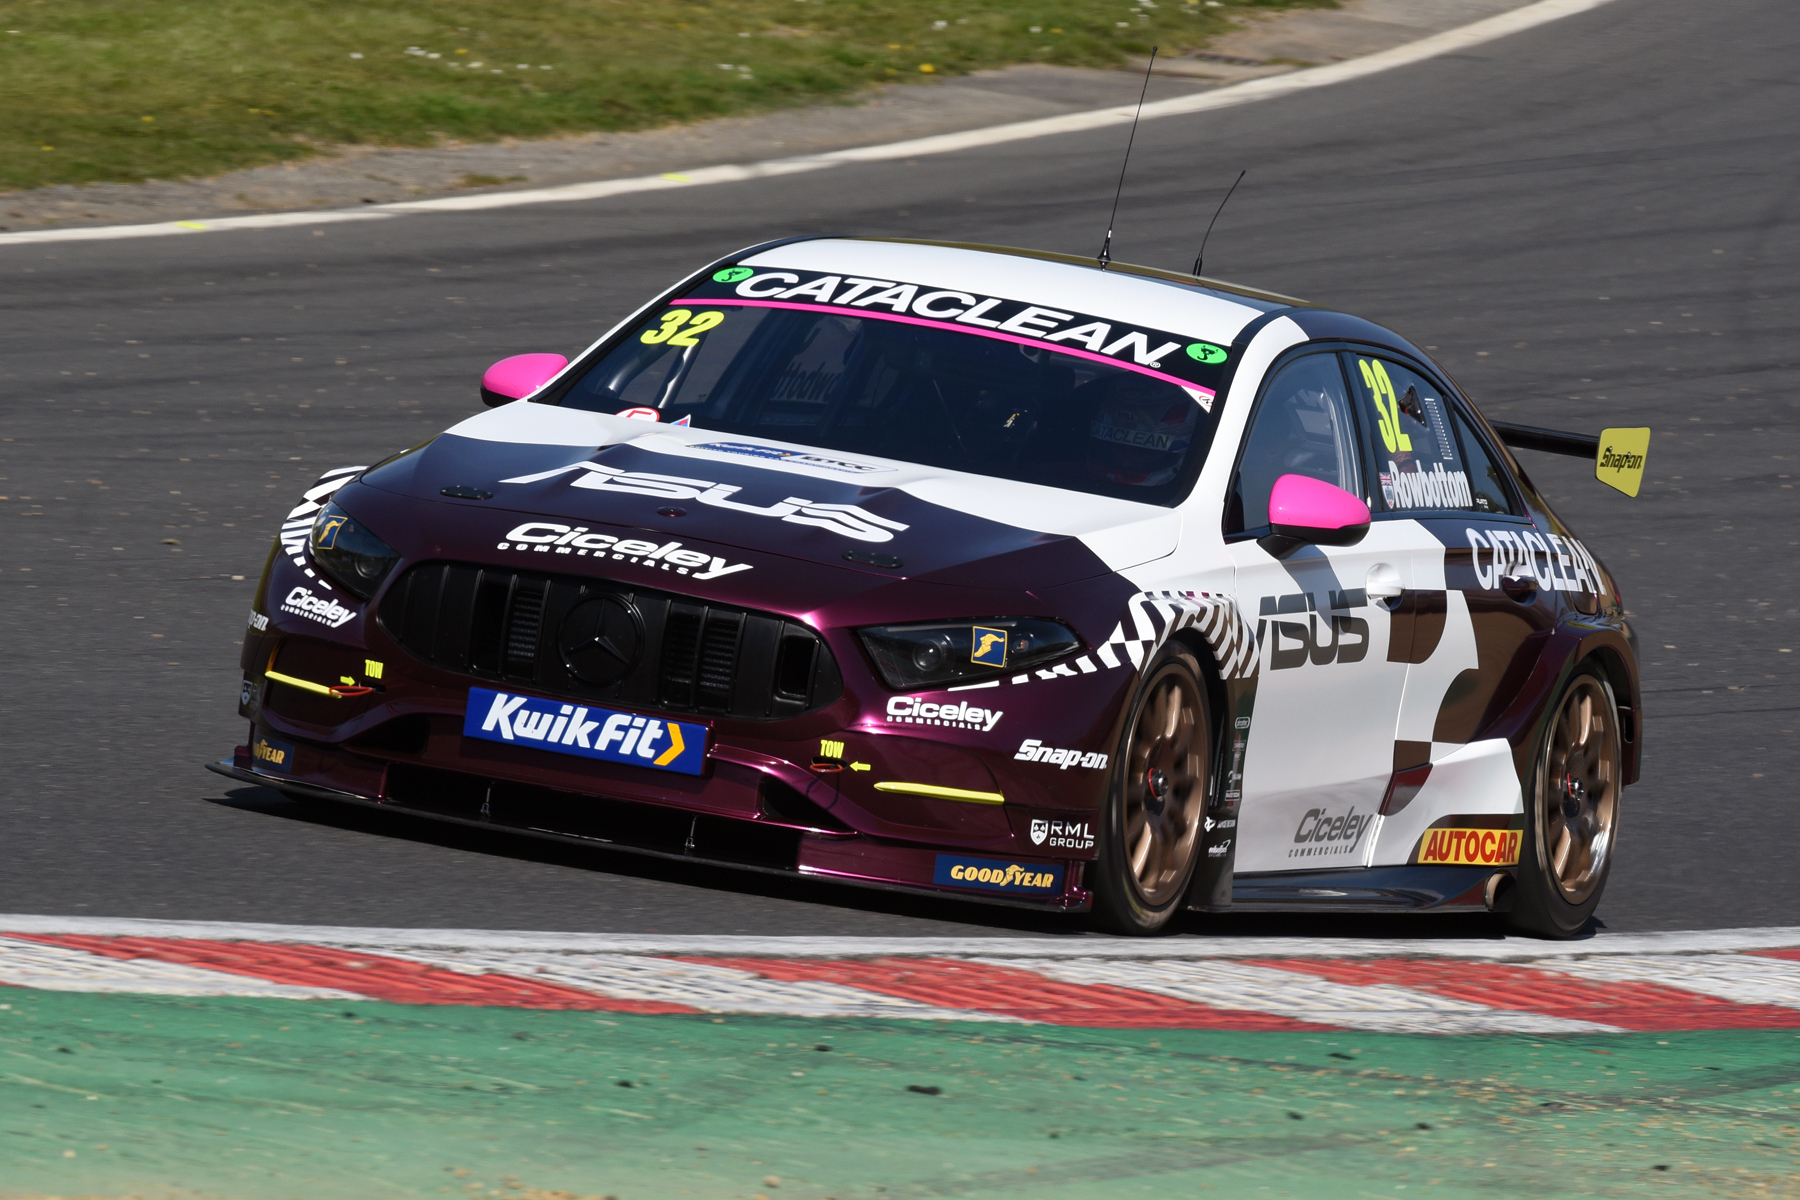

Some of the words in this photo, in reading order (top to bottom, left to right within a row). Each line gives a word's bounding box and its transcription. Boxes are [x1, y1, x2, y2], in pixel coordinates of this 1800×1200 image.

[640, 309, 724, 347] 32
[1358, 358, 1413, 453] 32
[1599, 446, 1644, 473] Snap-on
[498, 461, 910, 543] ASUS
[1388, 460, 1473, 509] Rowbottom
[497, 541, 689, 576] COMMERCIALS
[505, 522, 754, 580] Ciceley
[1465, 527, 1607, 596] CATACLEAN
[285, 586, 357, 628] Ciceley
[1253, 587, 1369, 671] ASUS
[365, 659, 384, 679] TOW
[886, 696, 1003, 732] Ciceley
[886, 716, 981, 731] COMMERCIALS
[820, 739, 845, 759] TOW
[1014, 739, 1109, 770] Snap-on
[1049, 837, 1095, 849] GROUP
[1050, 821, 1095, 839] RML
[1294, 806, 1373, 854] Ciceley
[1423, 830, 1518, 863] AUTOCAR
[1288, 844, 1350, 858] COMMERCIALS
